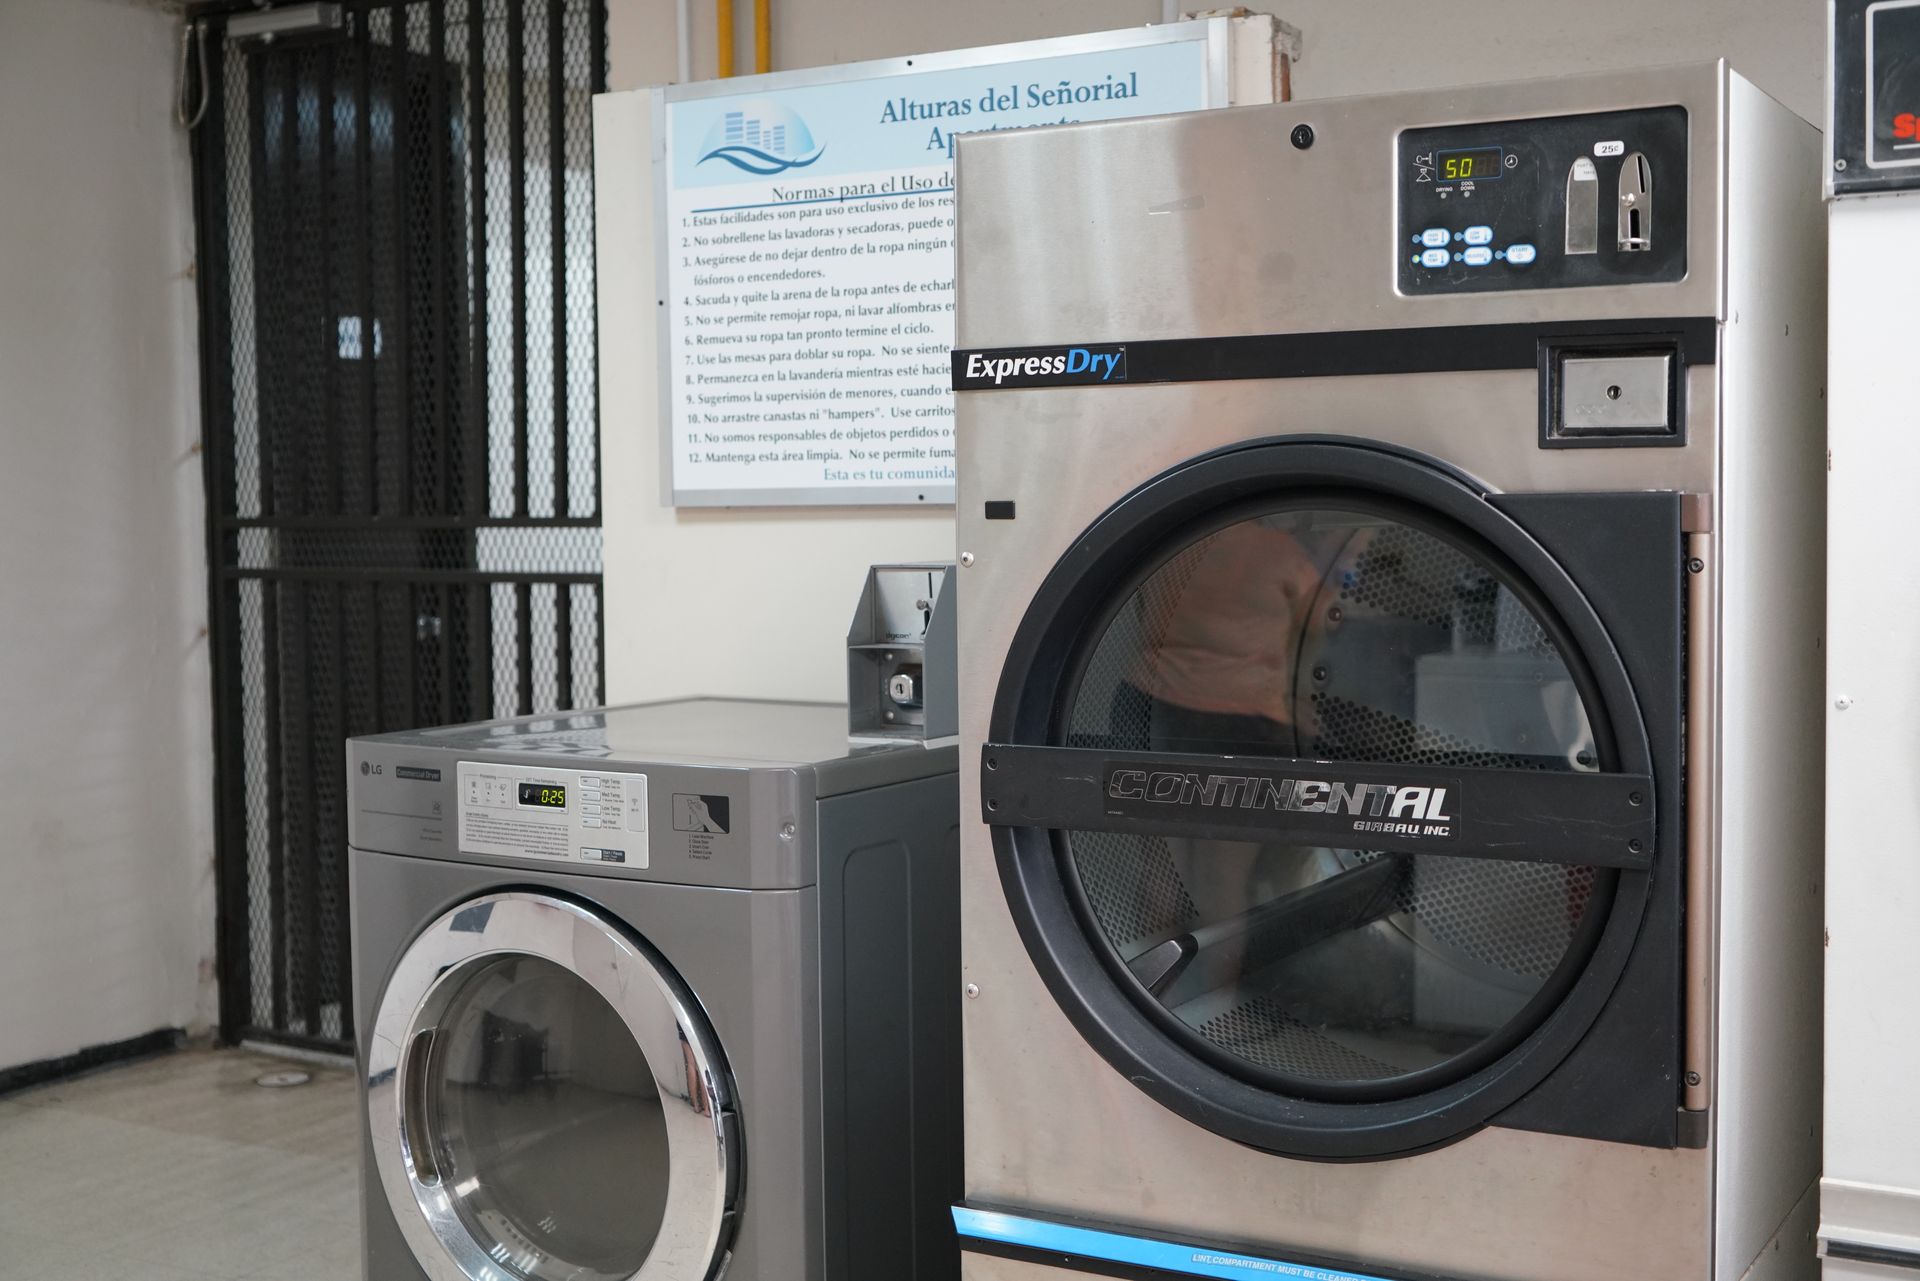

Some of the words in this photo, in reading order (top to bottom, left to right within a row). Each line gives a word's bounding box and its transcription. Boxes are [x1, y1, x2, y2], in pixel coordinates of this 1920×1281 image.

[879, 97, 972, 124] Alturas
[979, 85, 1019, 112] del
[1027, 71, 1139, 108] Señorial
[1893, 113, 1920, 142] S
[1446, 158, 1473, 179] 50
[771, 187, 835, 202] Normas
[839, 183, 875, 201] para
[880, 176, 895, 191] el
[901, 173, 933, 190] Uso
[682, 217, 690, 227] 1.
[692, 216, 717, 226] Estas
[719, 210, 775, 224] facilidades
[777, 210, 796, 220] son
[798, 208, 822, 221] para
[824, 206, 845, 216] uso
[847, 200, 899, 214] exclusivo
[900, 198, 916, 210] de
[918, 197, 935, 208] los
[682, 237, 691, 247] 2.
[693, 236, 709, 246] No
[711, 231, 766, 245] sobrellene
[767, 229, 782, 240] las
[784, 226, 835, 239] lavadoras
[837, 227, 843, 238] y
[846, 221, 904, 234] secadoras,
[907, 217, 944, 233] puede
[946, 218, 954, 227] o
[682, 256, 691, 267] 3.
[694, 253, 747, 268] Asegúrese
[748, 250, 762, 262] de
[764, 252, 779, 261] no
[781, 248, 808, 262] dejar
[810, 246, 847, 258] dentro
[849, 243, 864, 255] de
[866, 242, 876, 253] la
[878, 243, 905, 255] ropa
[907, 237, 947, 253] ningún
[693, 274, 735, 286] fósforos
[737, 275, 745, 283] o
[746, 268, 825, 282] encendedores.
[683, 296, 692, 306] 4.
[695, 293, 731, 305] Sacuda
[733, 296, 739, 306] y
[741, 291, 769, 306] quite
[770, 290, 780, 301] la
[782, 290, 812, 300] arena
[814, 287, 828, 298] de
[830, 287, 840, 297] la
[842, 287, 868, 299] ropa
[870, 284, 900, 295] antes
[902, 282, 917, 293] de
[684, 315, 693, 326] 5.
[695, 315, 711, 325] No
[713, 316, 724, 324] se
[726, 311, 767, 327] permite
[769, 308, 811, 323] remojar
[813, 309, 842, 321] ropa,
[844, 305, 855, 317] ni
[857, 305, 884, 316] lavar
[886, 301, 942, 315] alfombras
[944, 302, 955, 311] e
[684, 336, 693, 346] 6.
[696, 334, 743, 345] Remueva
[745, 334, 757, 342] su
[759, 333, 784, 344] ropa
[786, 331, 803, 340] tan
[805, 328, 843, 343] pronto
[845, 325, 888, 337] termine
[890, 324, 901, 335] el
[903, 323, 934, 334] ciclo.
[685, 355, 694, 365] 7.
[696, 354, 716, 365] Use
[718, 353, 732, 363] las
[734, 354, 766, 363] mesas
[768, 352, 792, 365] para
[794, 348, 829, 360] doblar
[831, 350, 844, 359] su
[846, 348, 875, 360] ropa.
[881, 345, 898, 356] No
[900, 346, 913, 355] se
[915, 343, 950, 354] siente
[685, 374, 694, 385] 8.
[697, 374, 759, 384] Permanezca
[761, 373, 775, 382] en
[776, 370, 787, 381] la
[788, 368, 843, 381] lavandería
[845, 367, 894, 378] mientras
[896, 364, 919, 376] esté
[921, 363, 952, 375] hacie
[966, 348, 1121, 384] ExpressDry
[685, 394, 694, 404] 9.
[697, 392, 751, 407] Sugerimos
[753, 391, 763, 402] la
[765, 389, 826, 404] supervisión
[828, 388, 843, 399] de
[845, 389, 897, 399] menores,
[899, 384, 942, 397] cuando
[687, 414, 701, 424] 10.
[703, 413, 719, 423] No
[720, 412, 761, 423] arrastre
[762, 411, 807, 421] canastas
[809, 409, 820, 420] ni
[890, 407, 912, 418] Use
[688, 433, 701, 443] 11.
[704, 433, 720, 443] No
[721, 434, 755, 442] somos
[757, 429, 827, 444] responsables
[829, 428, 843, 440] de
[845, 428, 887, 442] objetos
[889, 426, 939, 442] perdidos
[941, 428, 950, 437] o
[688, 453, 702, 463] 12.
[705, 452, 756, 465] Mantenga
[758, 451, 779, 462] esta
[781, 450, 804, 461] área
[806, 449, 843, 463] limpia.
[849, 449, 866, 459] No
[867, 451, 880, 459] se
[882, 447, 926, 463] permite
[823, 468, 849, 480] Esta
[852, 471, 866, 480] es
[869, 469, 883, 480] tu
[886, 466, 955, 480] comunida
[371, 764, 382, 775] LG
[1108, 769, 1450, 821] CONTINENTAL
[1212, 1256, 1276, 1271] COMPARTMENT
[1277, 1265, 1301, 1276] MUST
[1303, 1269, 1315, 1278] BE
